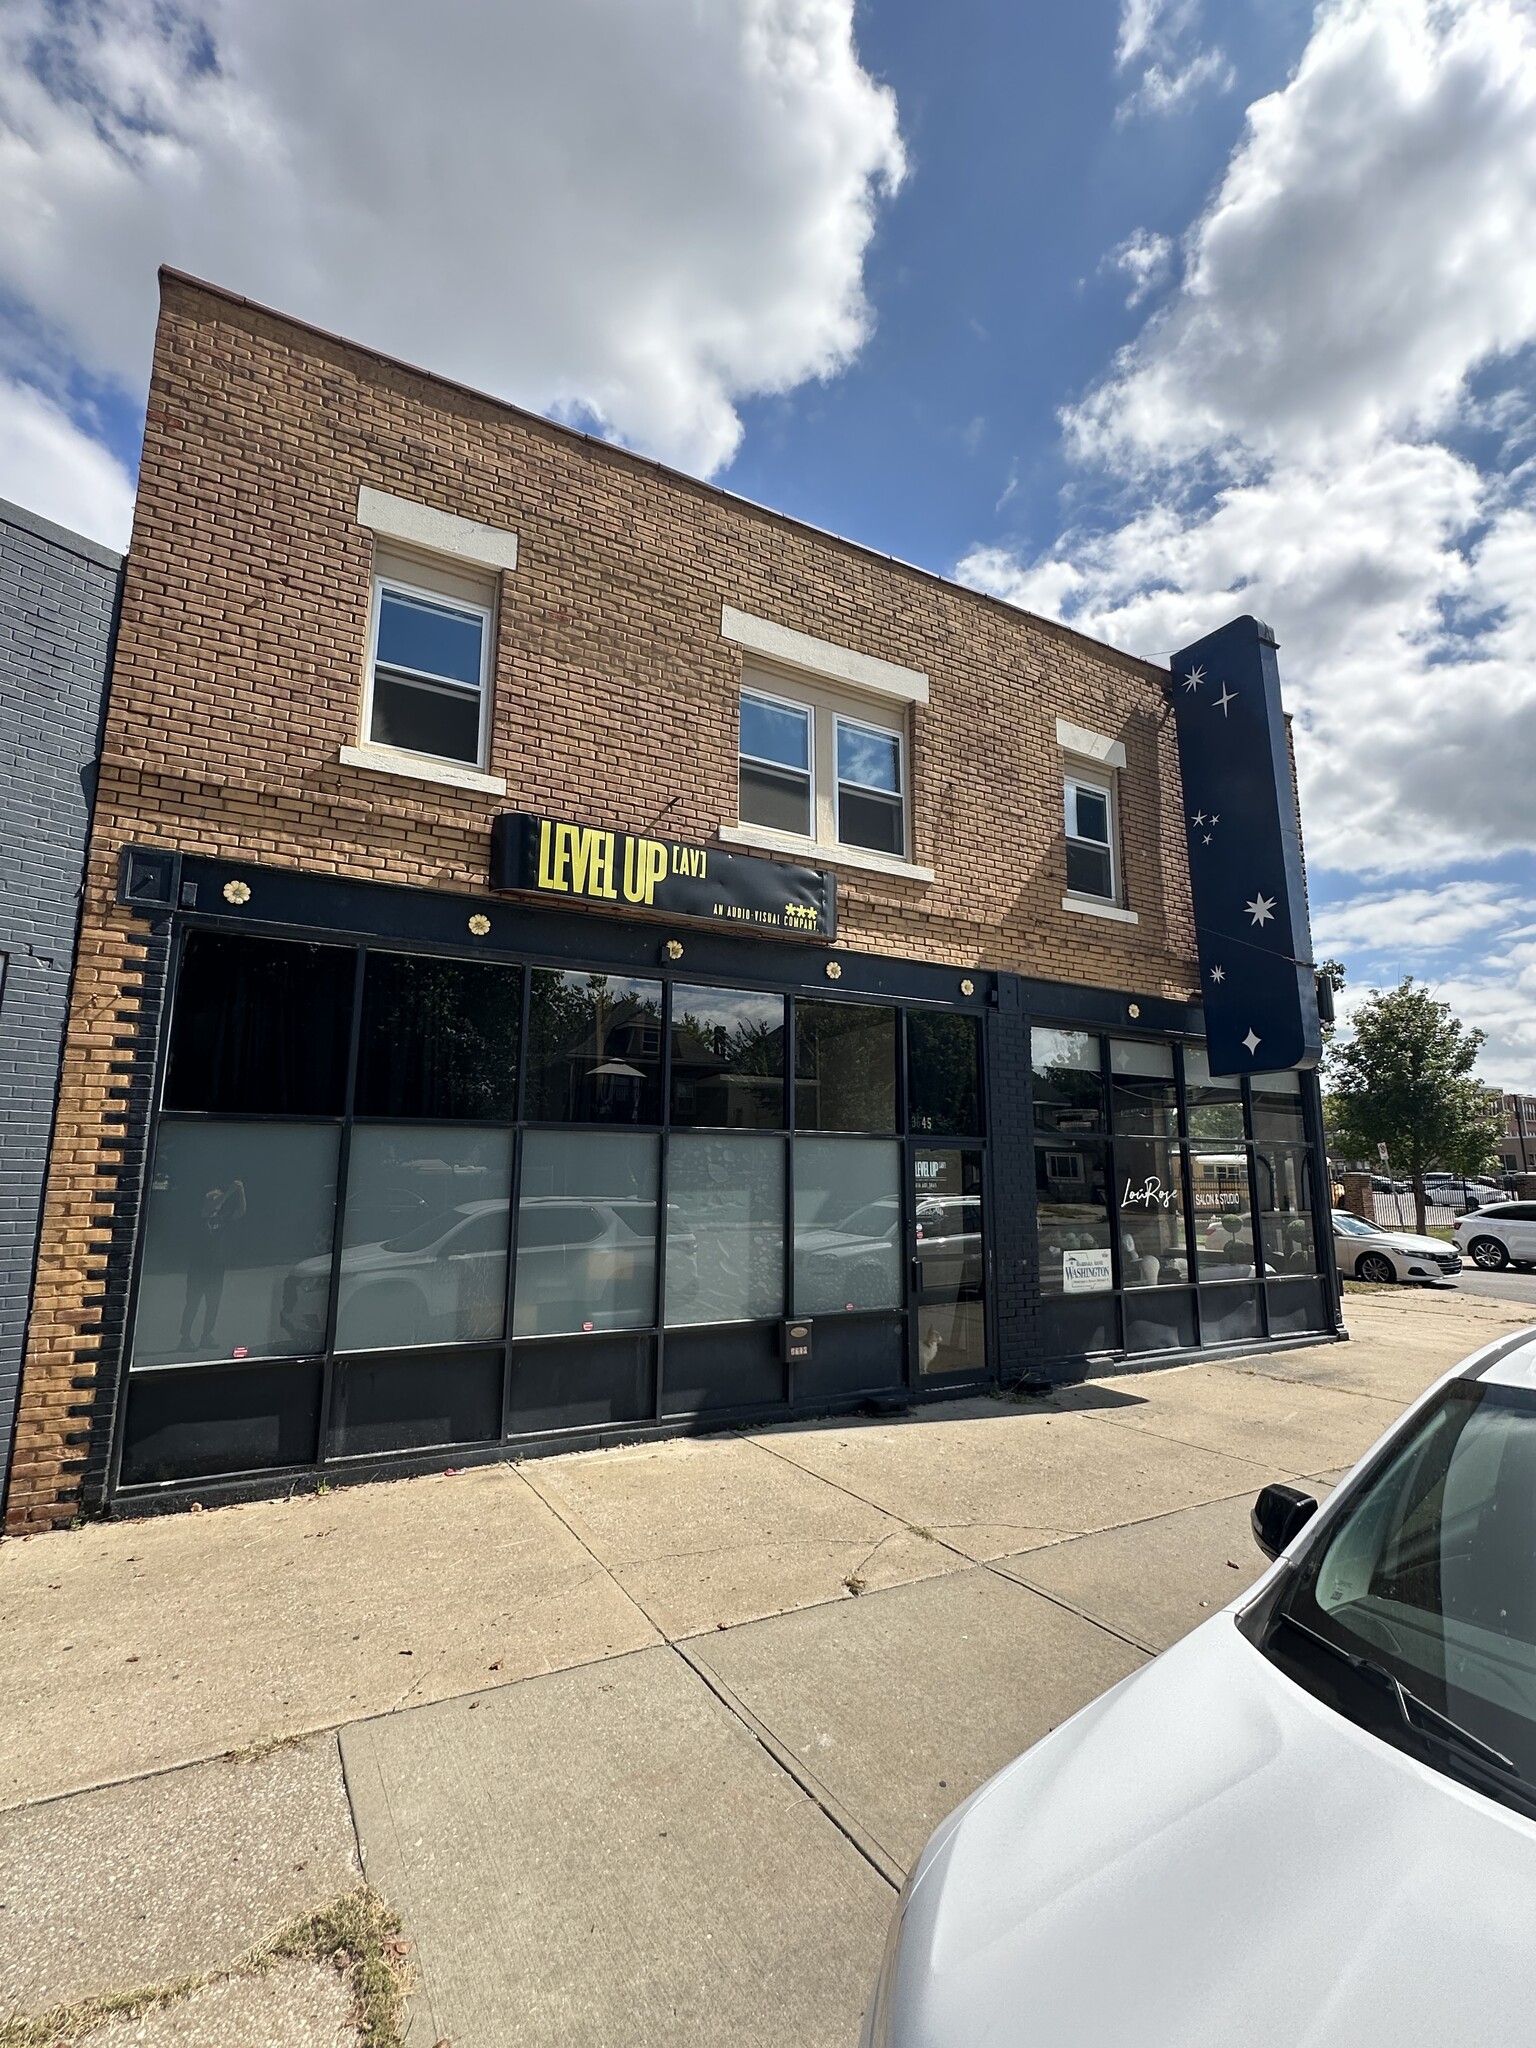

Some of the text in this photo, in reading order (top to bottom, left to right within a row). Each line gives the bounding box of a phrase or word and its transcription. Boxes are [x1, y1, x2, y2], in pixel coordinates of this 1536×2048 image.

[538, 820, 707, 905] LEVEL UP [AV]
[713, 903, 723, 916] AN
[915, 1161, 929, 1177] LEVEL
[929, 1161, 939, 1177] UP
[1195, 1193, 1214, 1206] SALON
[1219, 1193, 1240, 1205] STUDIO
[1065, 1266, 1110, 1280] WASHINGTON
